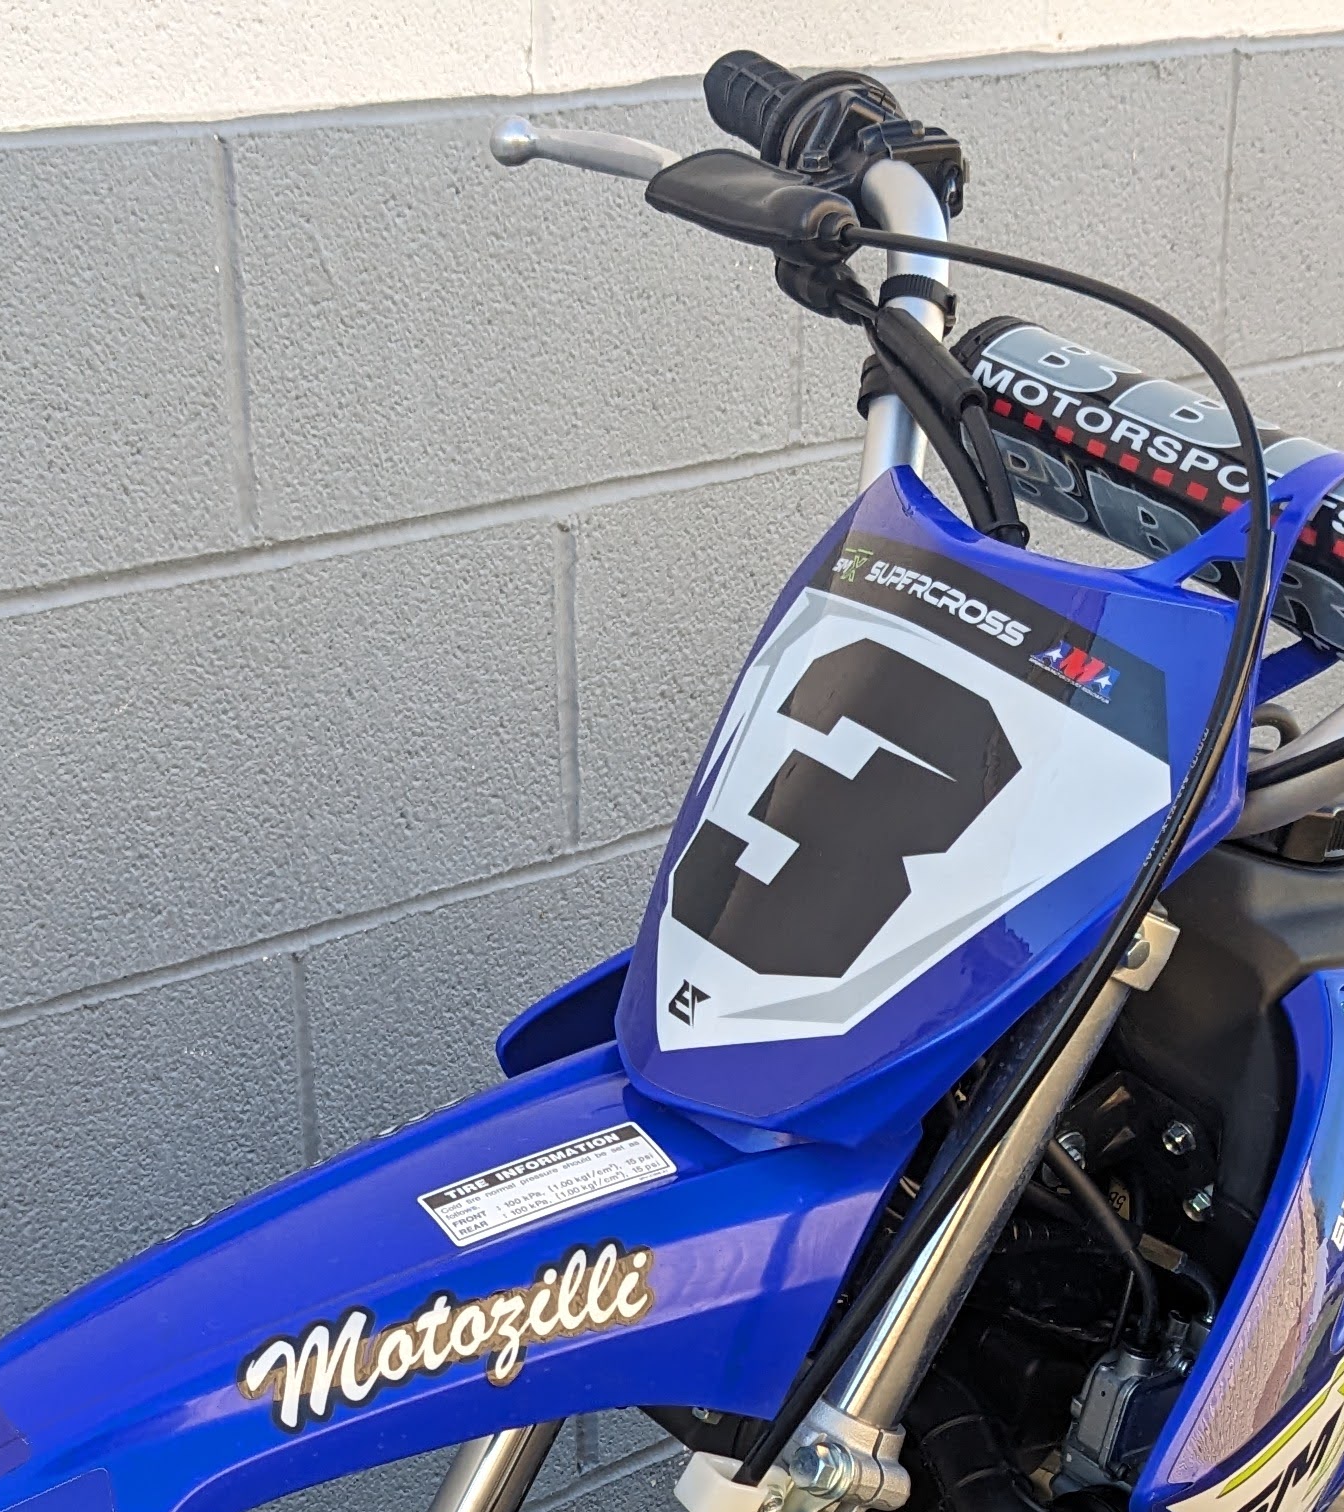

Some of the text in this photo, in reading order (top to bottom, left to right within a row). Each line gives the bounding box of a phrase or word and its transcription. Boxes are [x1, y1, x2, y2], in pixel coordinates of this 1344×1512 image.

[864, 560, 1032, 647] SUPERCROSS
[670, 637, 1022, 978] 3
[440, 1203, 463, 1215] Cold
[465, 1195, 482, 1206] tire
[485, 1182, 516, 1198] normal
[520, 1168, 559, 1187] pressure
[562, 1154, 592, 1171] should
[594, 1148, 607, 1158] be
[610, 1143, 625, 1154] set
[443, 1132, 621, 1201] TIRE INFORMATION
[452, 1210, 487, 1229] FRONT
[503, 1197, 522, 1209] 100
[625, 1156, 637, 1166] 15
[639, 1152, 655, 1165] psi
[458, 1220, 489, 1236] REAR
[510, 1205, 529, 1217] 100
[632, 1164, 644, 1175] 15
[646, 1160, 661, 1173] psi
[244, 1242, 648, 1429] Motozilli
